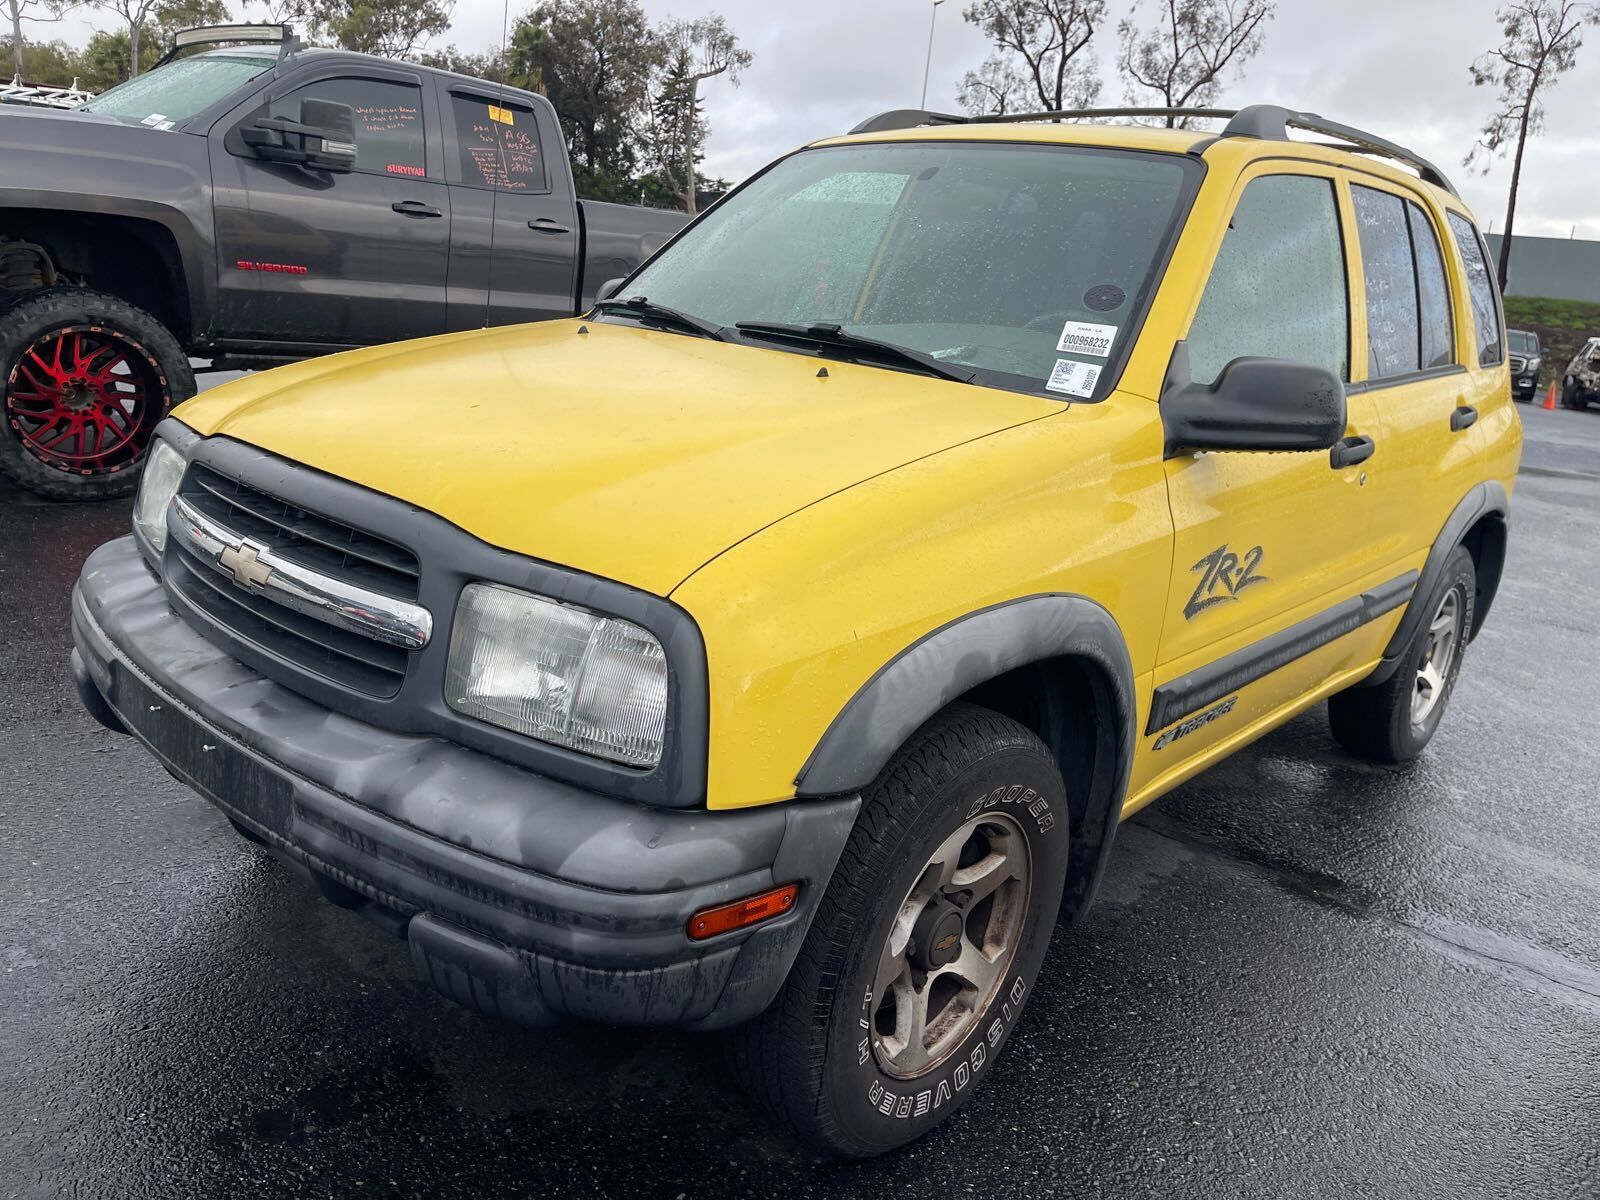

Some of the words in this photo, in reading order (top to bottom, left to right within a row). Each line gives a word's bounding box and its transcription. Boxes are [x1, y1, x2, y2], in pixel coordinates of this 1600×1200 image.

[236, 260, 308, 275] SILVERADO
[1063, 334, 1110, 349] 000968232
[1183, 544, 1270, 620] ZR-2
[966, 784, 1055, 833] COOPER
[868, 975, 1027, 1118] DISCOVERER
